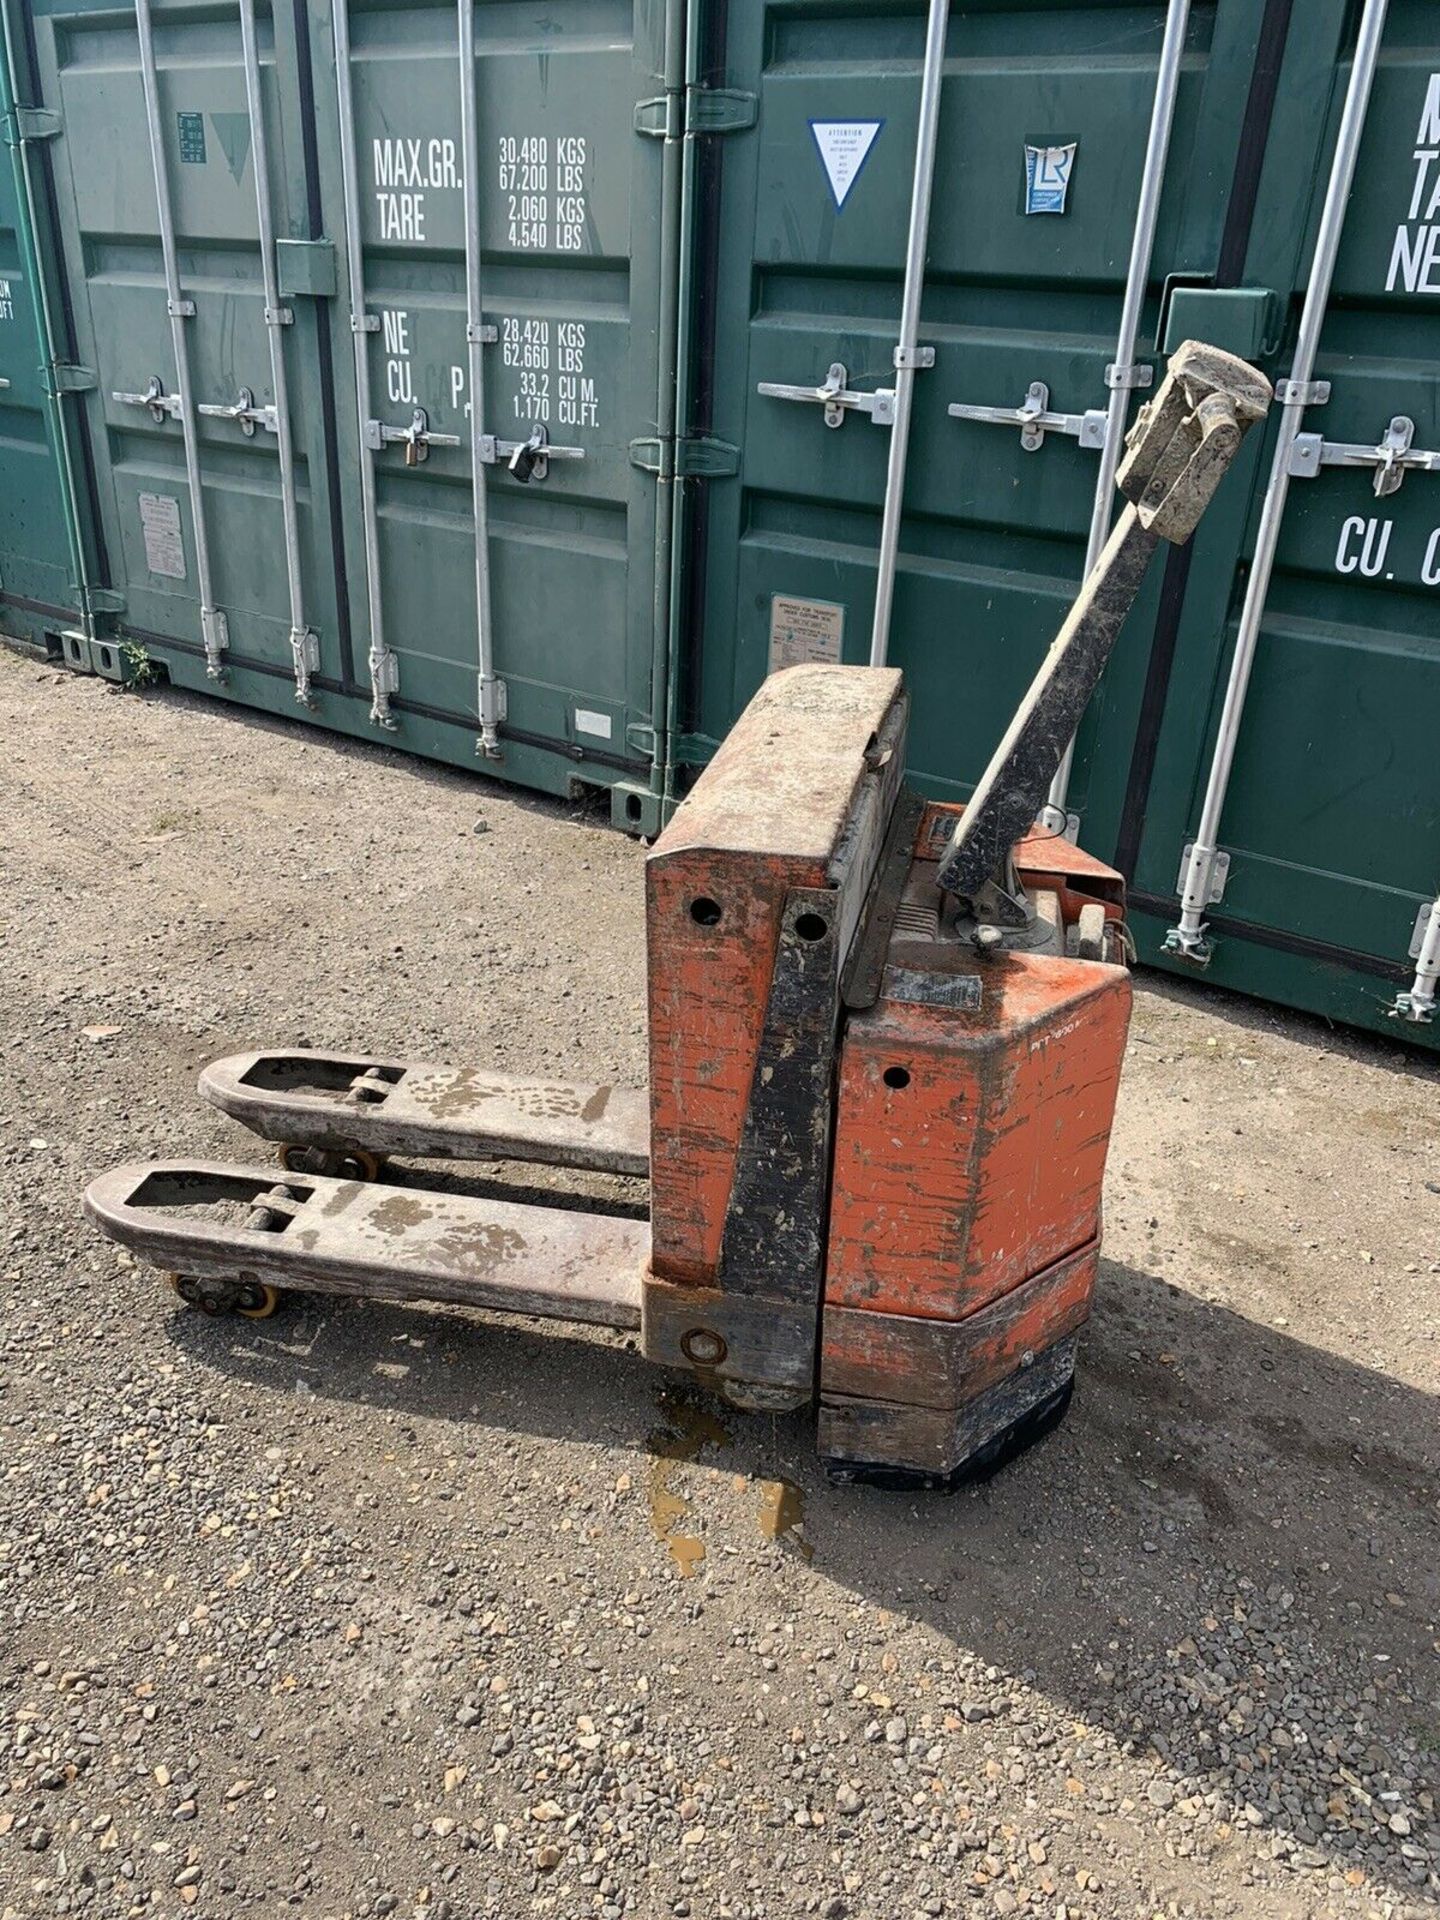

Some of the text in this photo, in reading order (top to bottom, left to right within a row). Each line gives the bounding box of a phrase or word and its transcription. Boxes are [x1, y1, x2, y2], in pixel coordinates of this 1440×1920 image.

[373, 139, 463, 188] MAX.GR.
[499, 137, 586, 165] 30,480 KGS
[499, 164, 583, 193] 67,200 LBS
[376, 193, 425, 241] TARE
[508, 195, 585, 223] 2,060 KGS
[508, 222, 582, 250] 4,540 LBS
[383, 311, 410, 355] NE
[503, 318, 585, 348] 28,420 KGS
[503, 343, 583, 373] 62,660 LBS
[387, 359, 418, 404] CU.
[520, 371, 550, 397] 33.2
[513, 394, 600, 427] 1,170 CU.FT.
[1334, 515, 1395, 580] CU.
